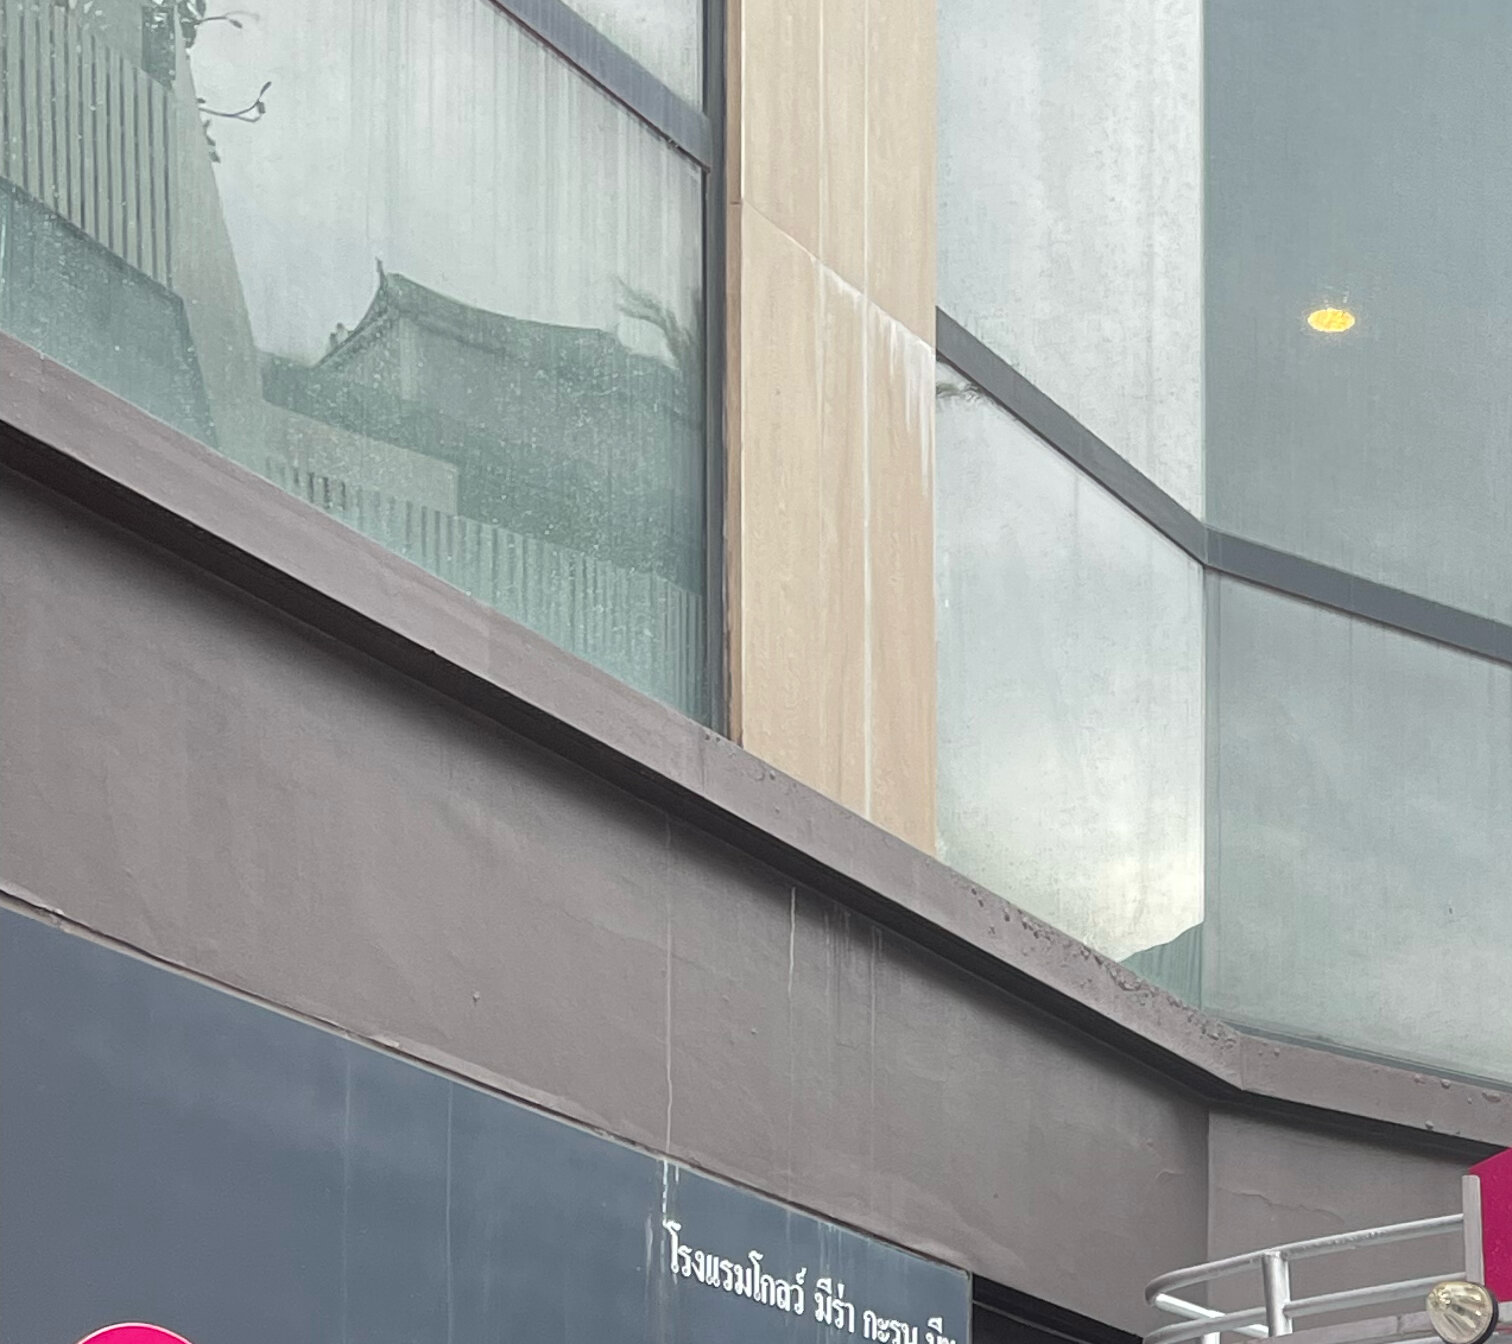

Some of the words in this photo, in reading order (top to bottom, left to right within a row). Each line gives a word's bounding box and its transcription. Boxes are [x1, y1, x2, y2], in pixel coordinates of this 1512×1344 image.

[662, 1219, 807, 1316] โรงแรมโกลว์
[814, 1277, 855, 1333] มีร่า
